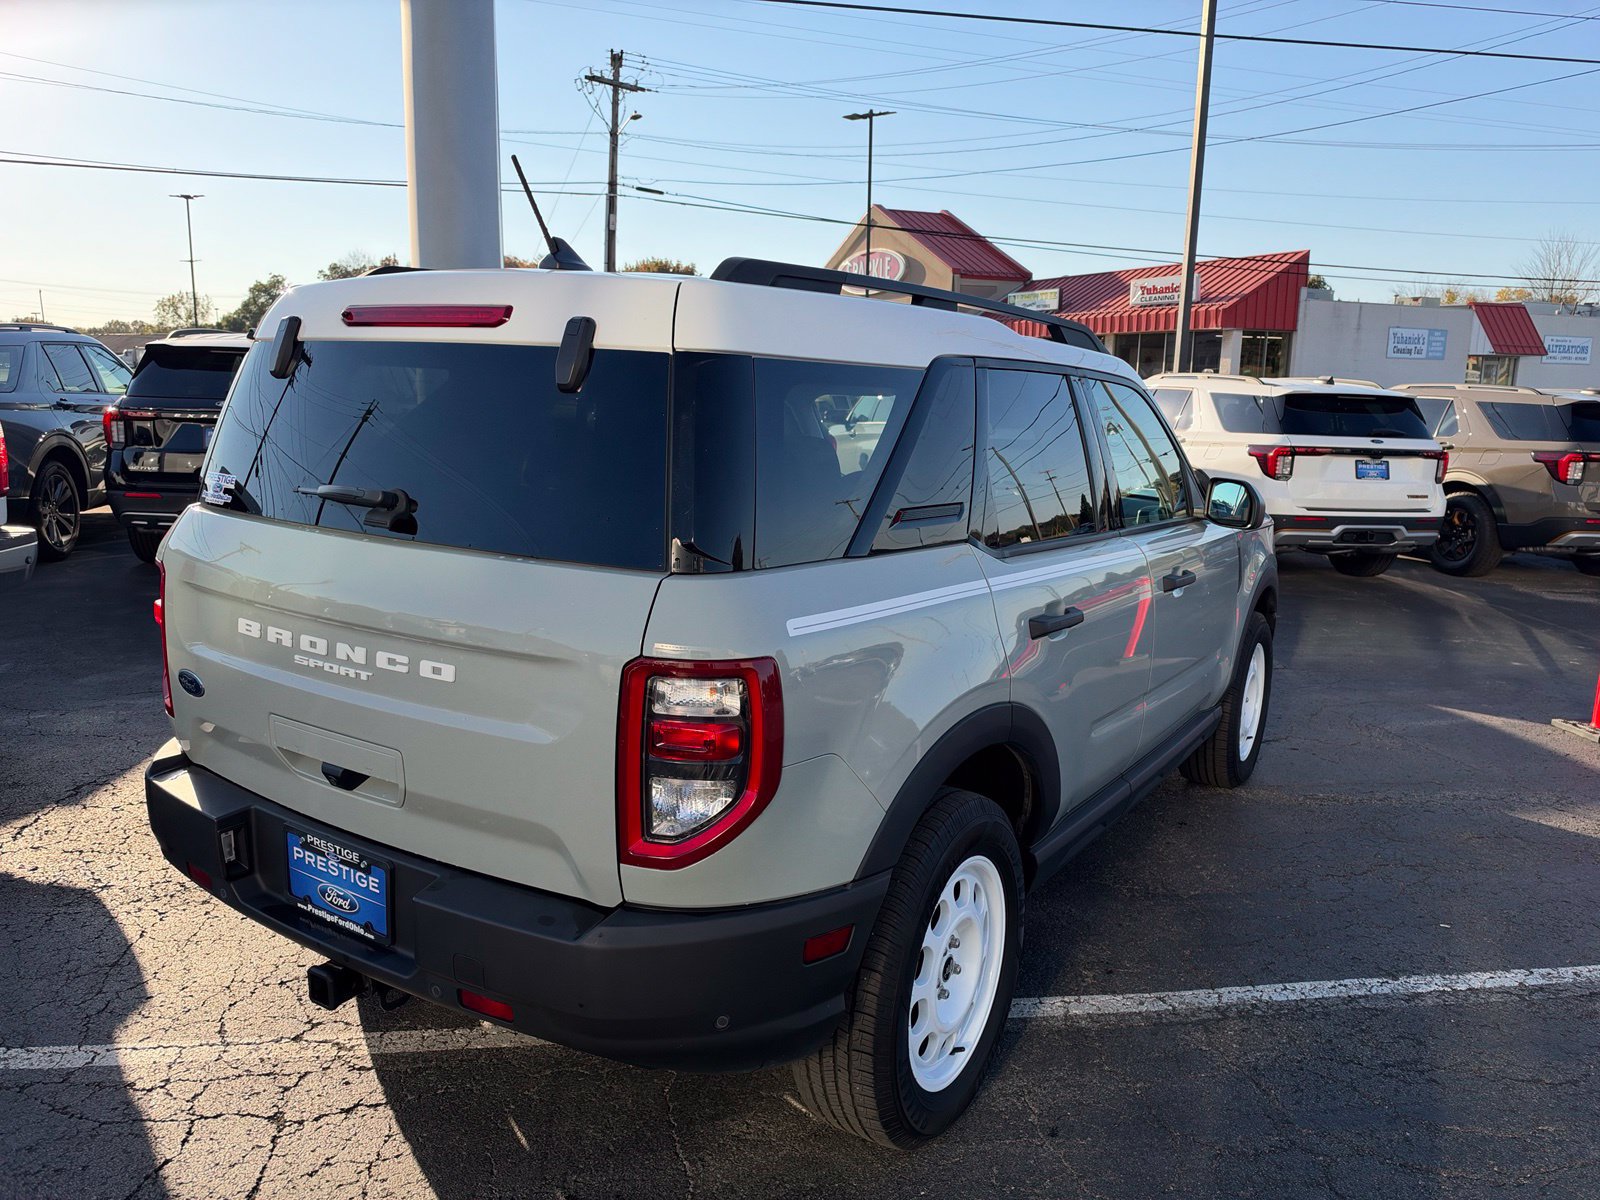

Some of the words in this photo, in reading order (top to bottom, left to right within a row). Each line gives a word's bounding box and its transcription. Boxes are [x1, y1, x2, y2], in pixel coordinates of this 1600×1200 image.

[1140, 294, 1175, 303] CLEANING
[1547, 344, 1589, 355] ALTERATIONS
[237, 617, 456, 682] BRONCO
[294, 654, 373, 681] SPORT
[306, 834, 360, 862] PRESTIGE
[293, 846, 380, 894] PRESTIGE
[325, 886, 351, 910] Ford
[297, 902, 375, 940] www.PrestigeFordOhio.com
